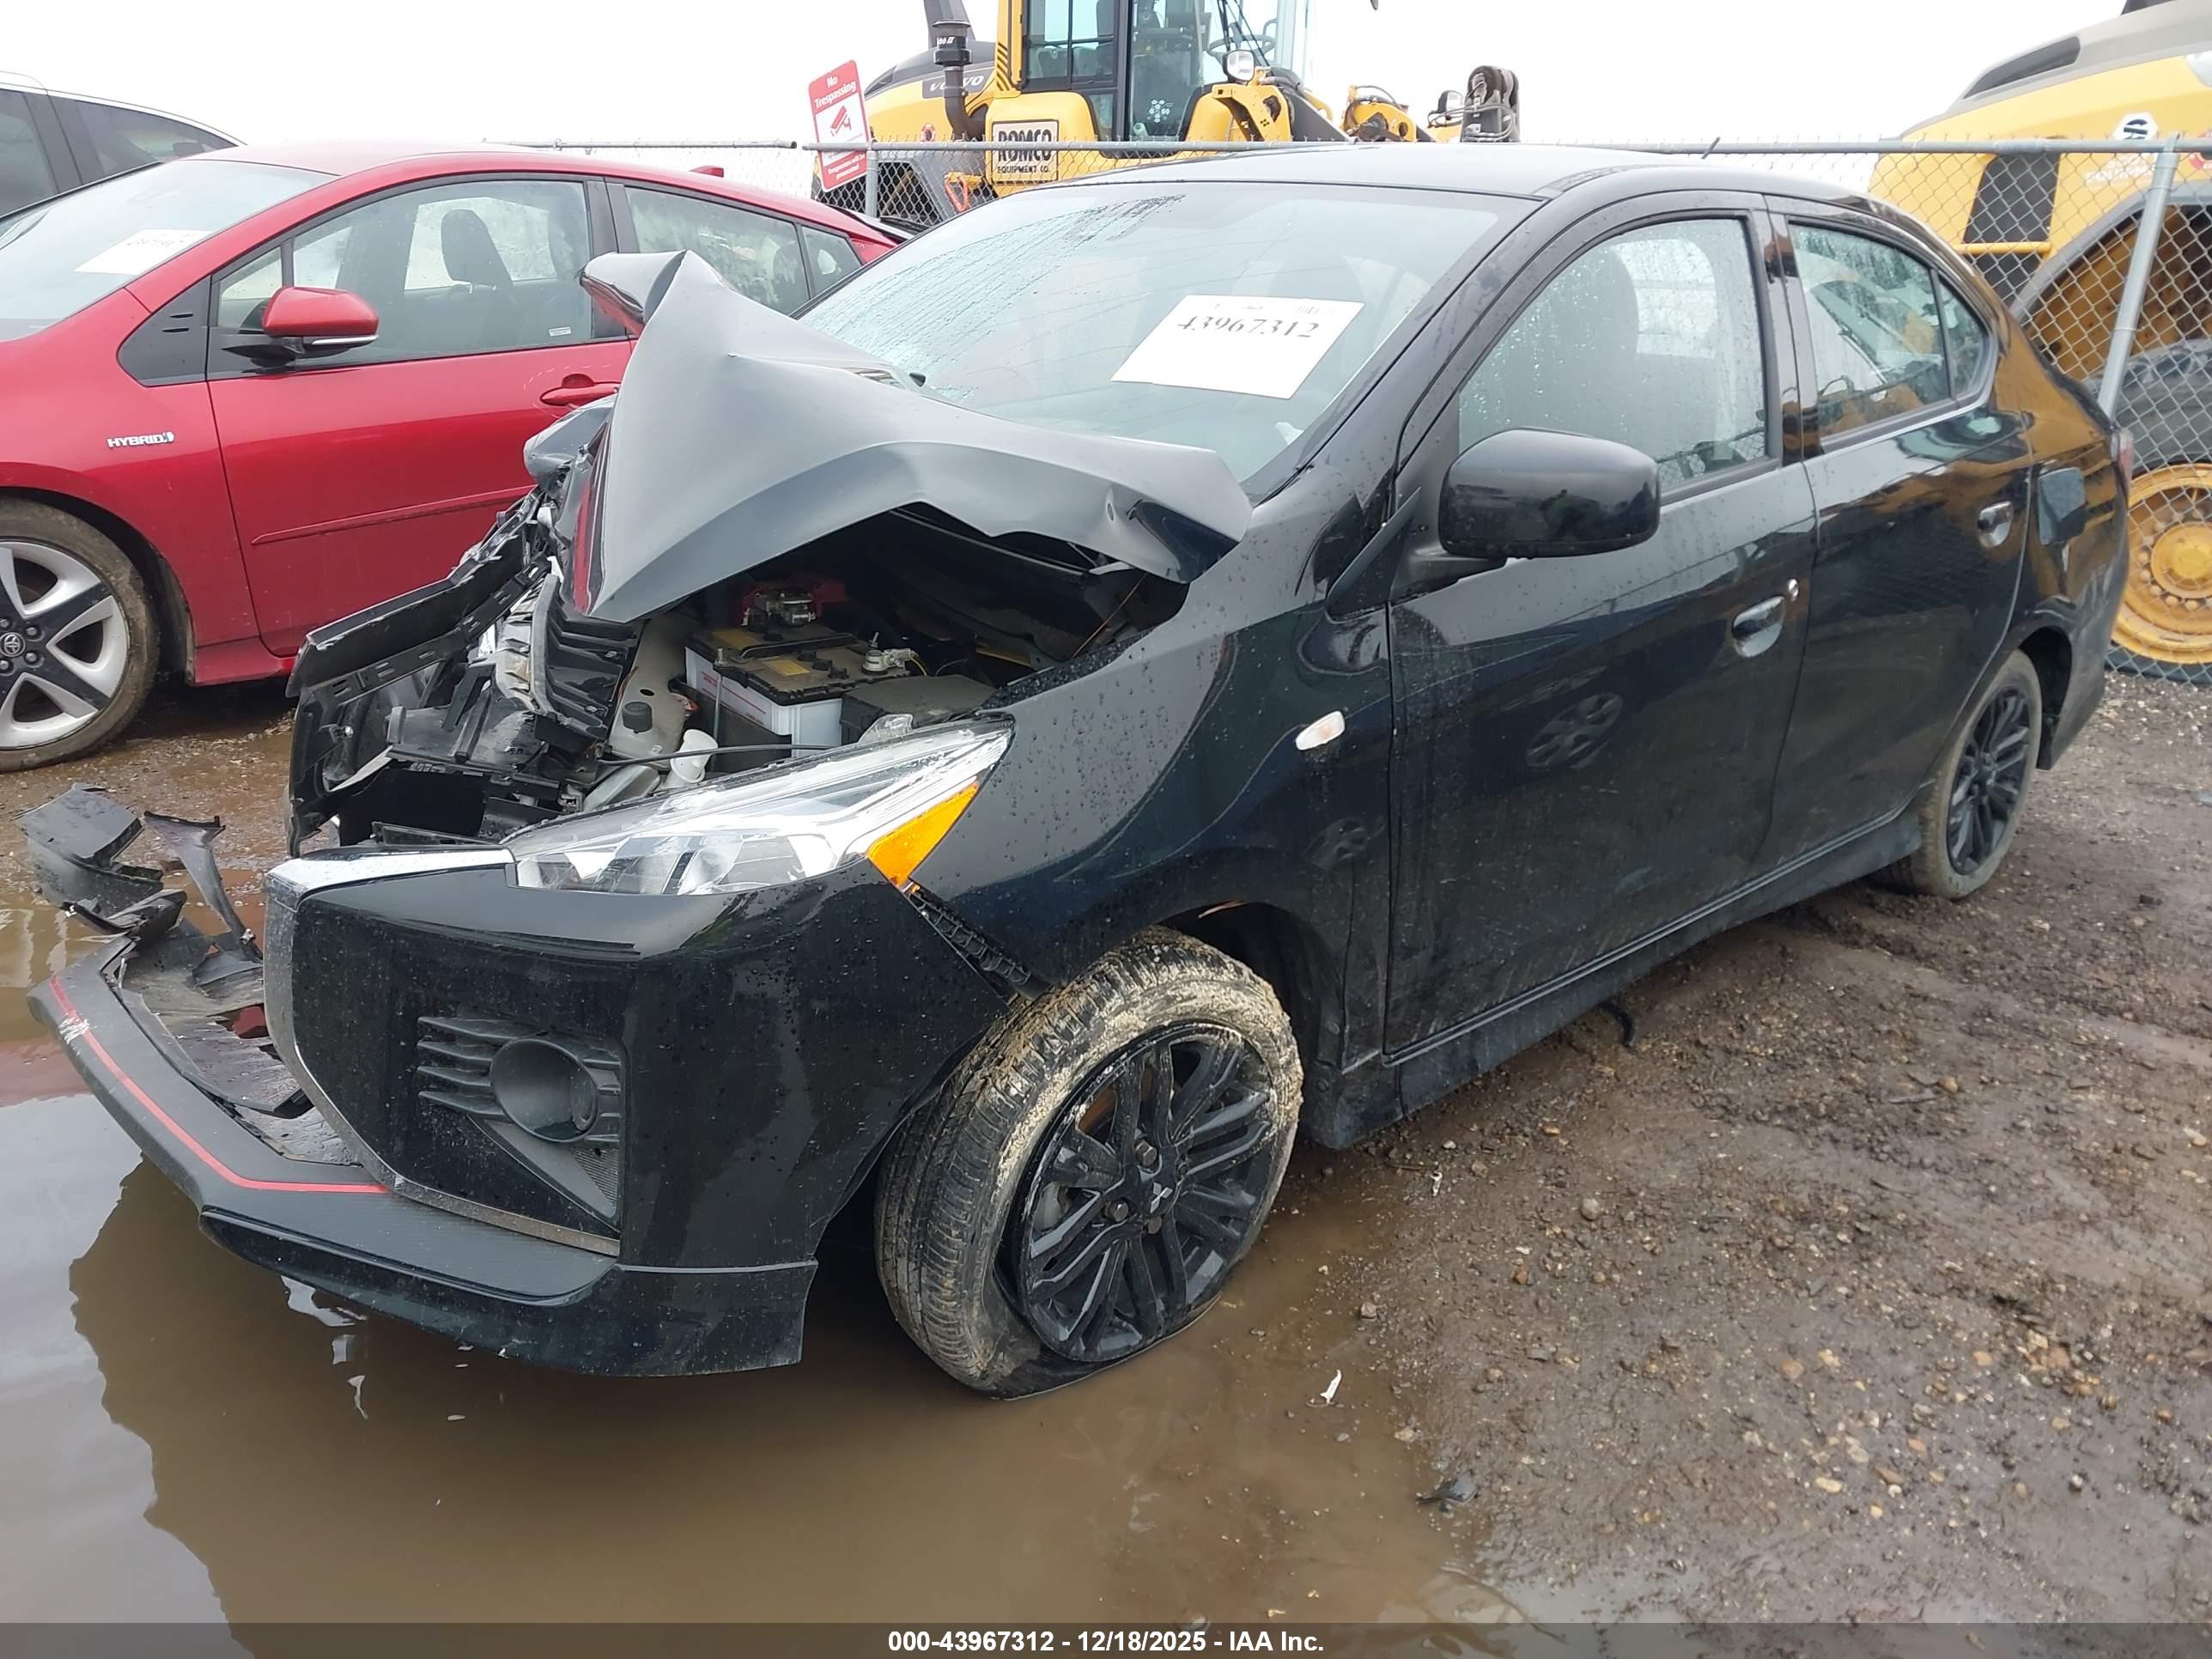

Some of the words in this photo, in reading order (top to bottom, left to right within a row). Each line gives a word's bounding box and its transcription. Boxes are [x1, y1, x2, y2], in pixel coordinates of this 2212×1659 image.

[826, 76, 838, 88] No
[814, 81, 857, 108] Trespassing
[998, 129, 1052, 161] ROMCO
[1177, 315, 1320, 337] 43967312
[106, 434, 162, 448] HYBRID
